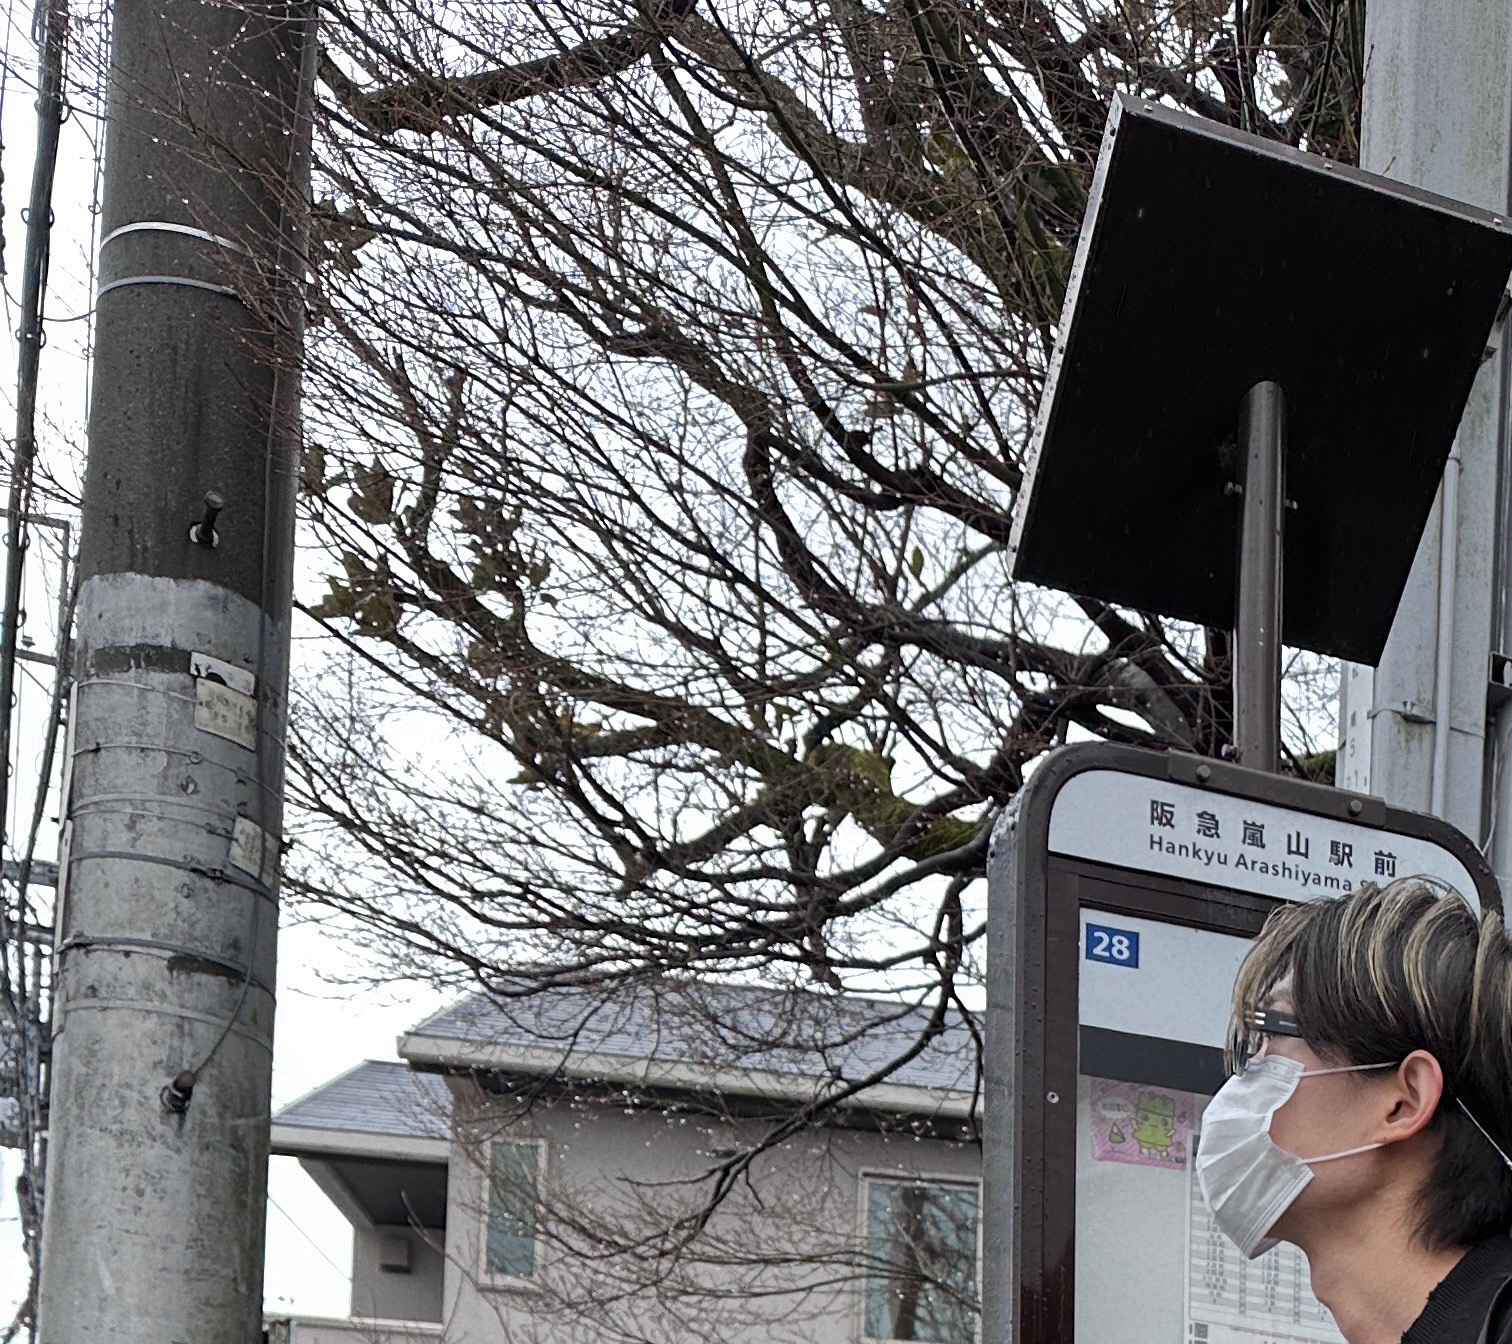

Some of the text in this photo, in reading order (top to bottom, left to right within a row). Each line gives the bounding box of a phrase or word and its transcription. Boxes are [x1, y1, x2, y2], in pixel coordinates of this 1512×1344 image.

[1149, 833, 1352, 892] Hankyu Arashiyama
[1150, 799, 1397, 878] 阪急嵐山駅前
[1092, 931, 1131, 961] 28
